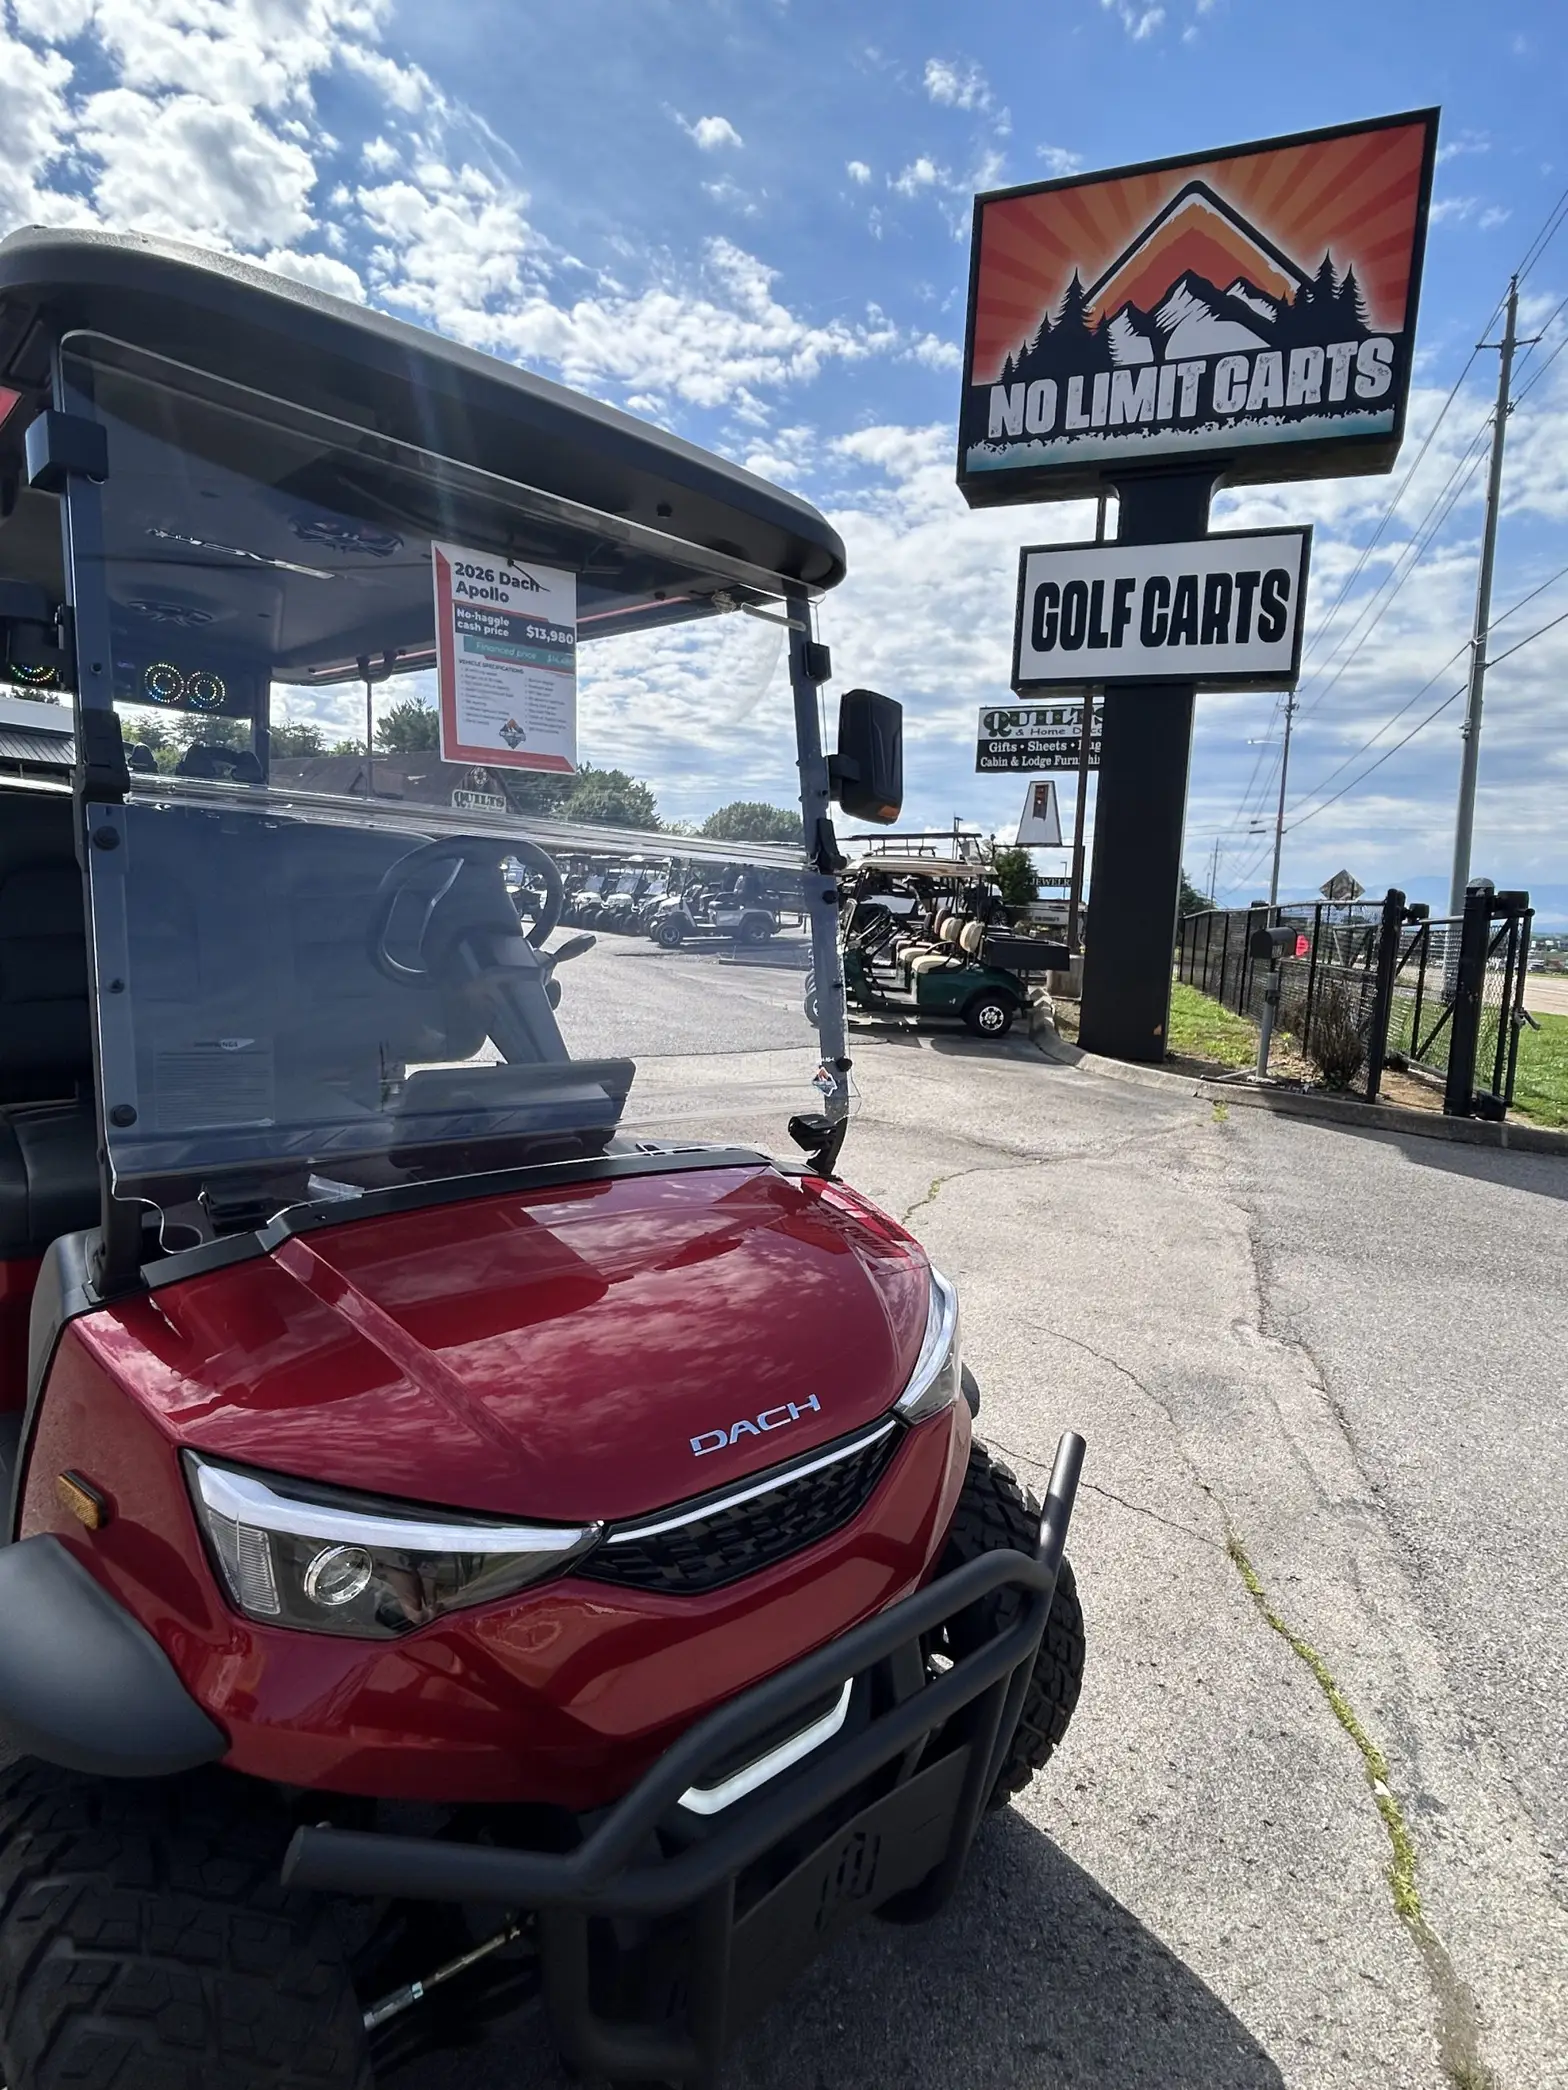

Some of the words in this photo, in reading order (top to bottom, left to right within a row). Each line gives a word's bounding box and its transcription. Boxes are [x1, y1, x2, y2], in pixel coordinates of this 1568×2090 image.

[988, 378, 1057, 439] NO
[1064, 358, 1207, 431] LIMIT
[1211, 337, 1396, 415] CARTS
[454, 561, 495, 583] 2026
[499, 571, 541, 593] Dach
[455, 580, 510, 603] Apollo
[456, 608, 510, 628] No-haggle
[1031, 576, 1136, 653] GOLF
[1140, 567, 1292, 648] CARTS
[457, 620, 482, 632] cash
[483, 625, 510, 637] price
[526, 624, 574, 645] $13,980
[1016, 728, 1025, 737] &
[1030, 727, 1066, 736] Home
[989, 740, 1018, 753] Gifts
[1027, 740, 1067, 752] Sheets
[980, 756, 1009, 768] Cabin
[1011, 757, 1019, 767] &
[1022, 755, 1052, 769] Lodge
[454, 791, 505, 808] QUILTS
[689, 1393, 822, 1457] DACH
